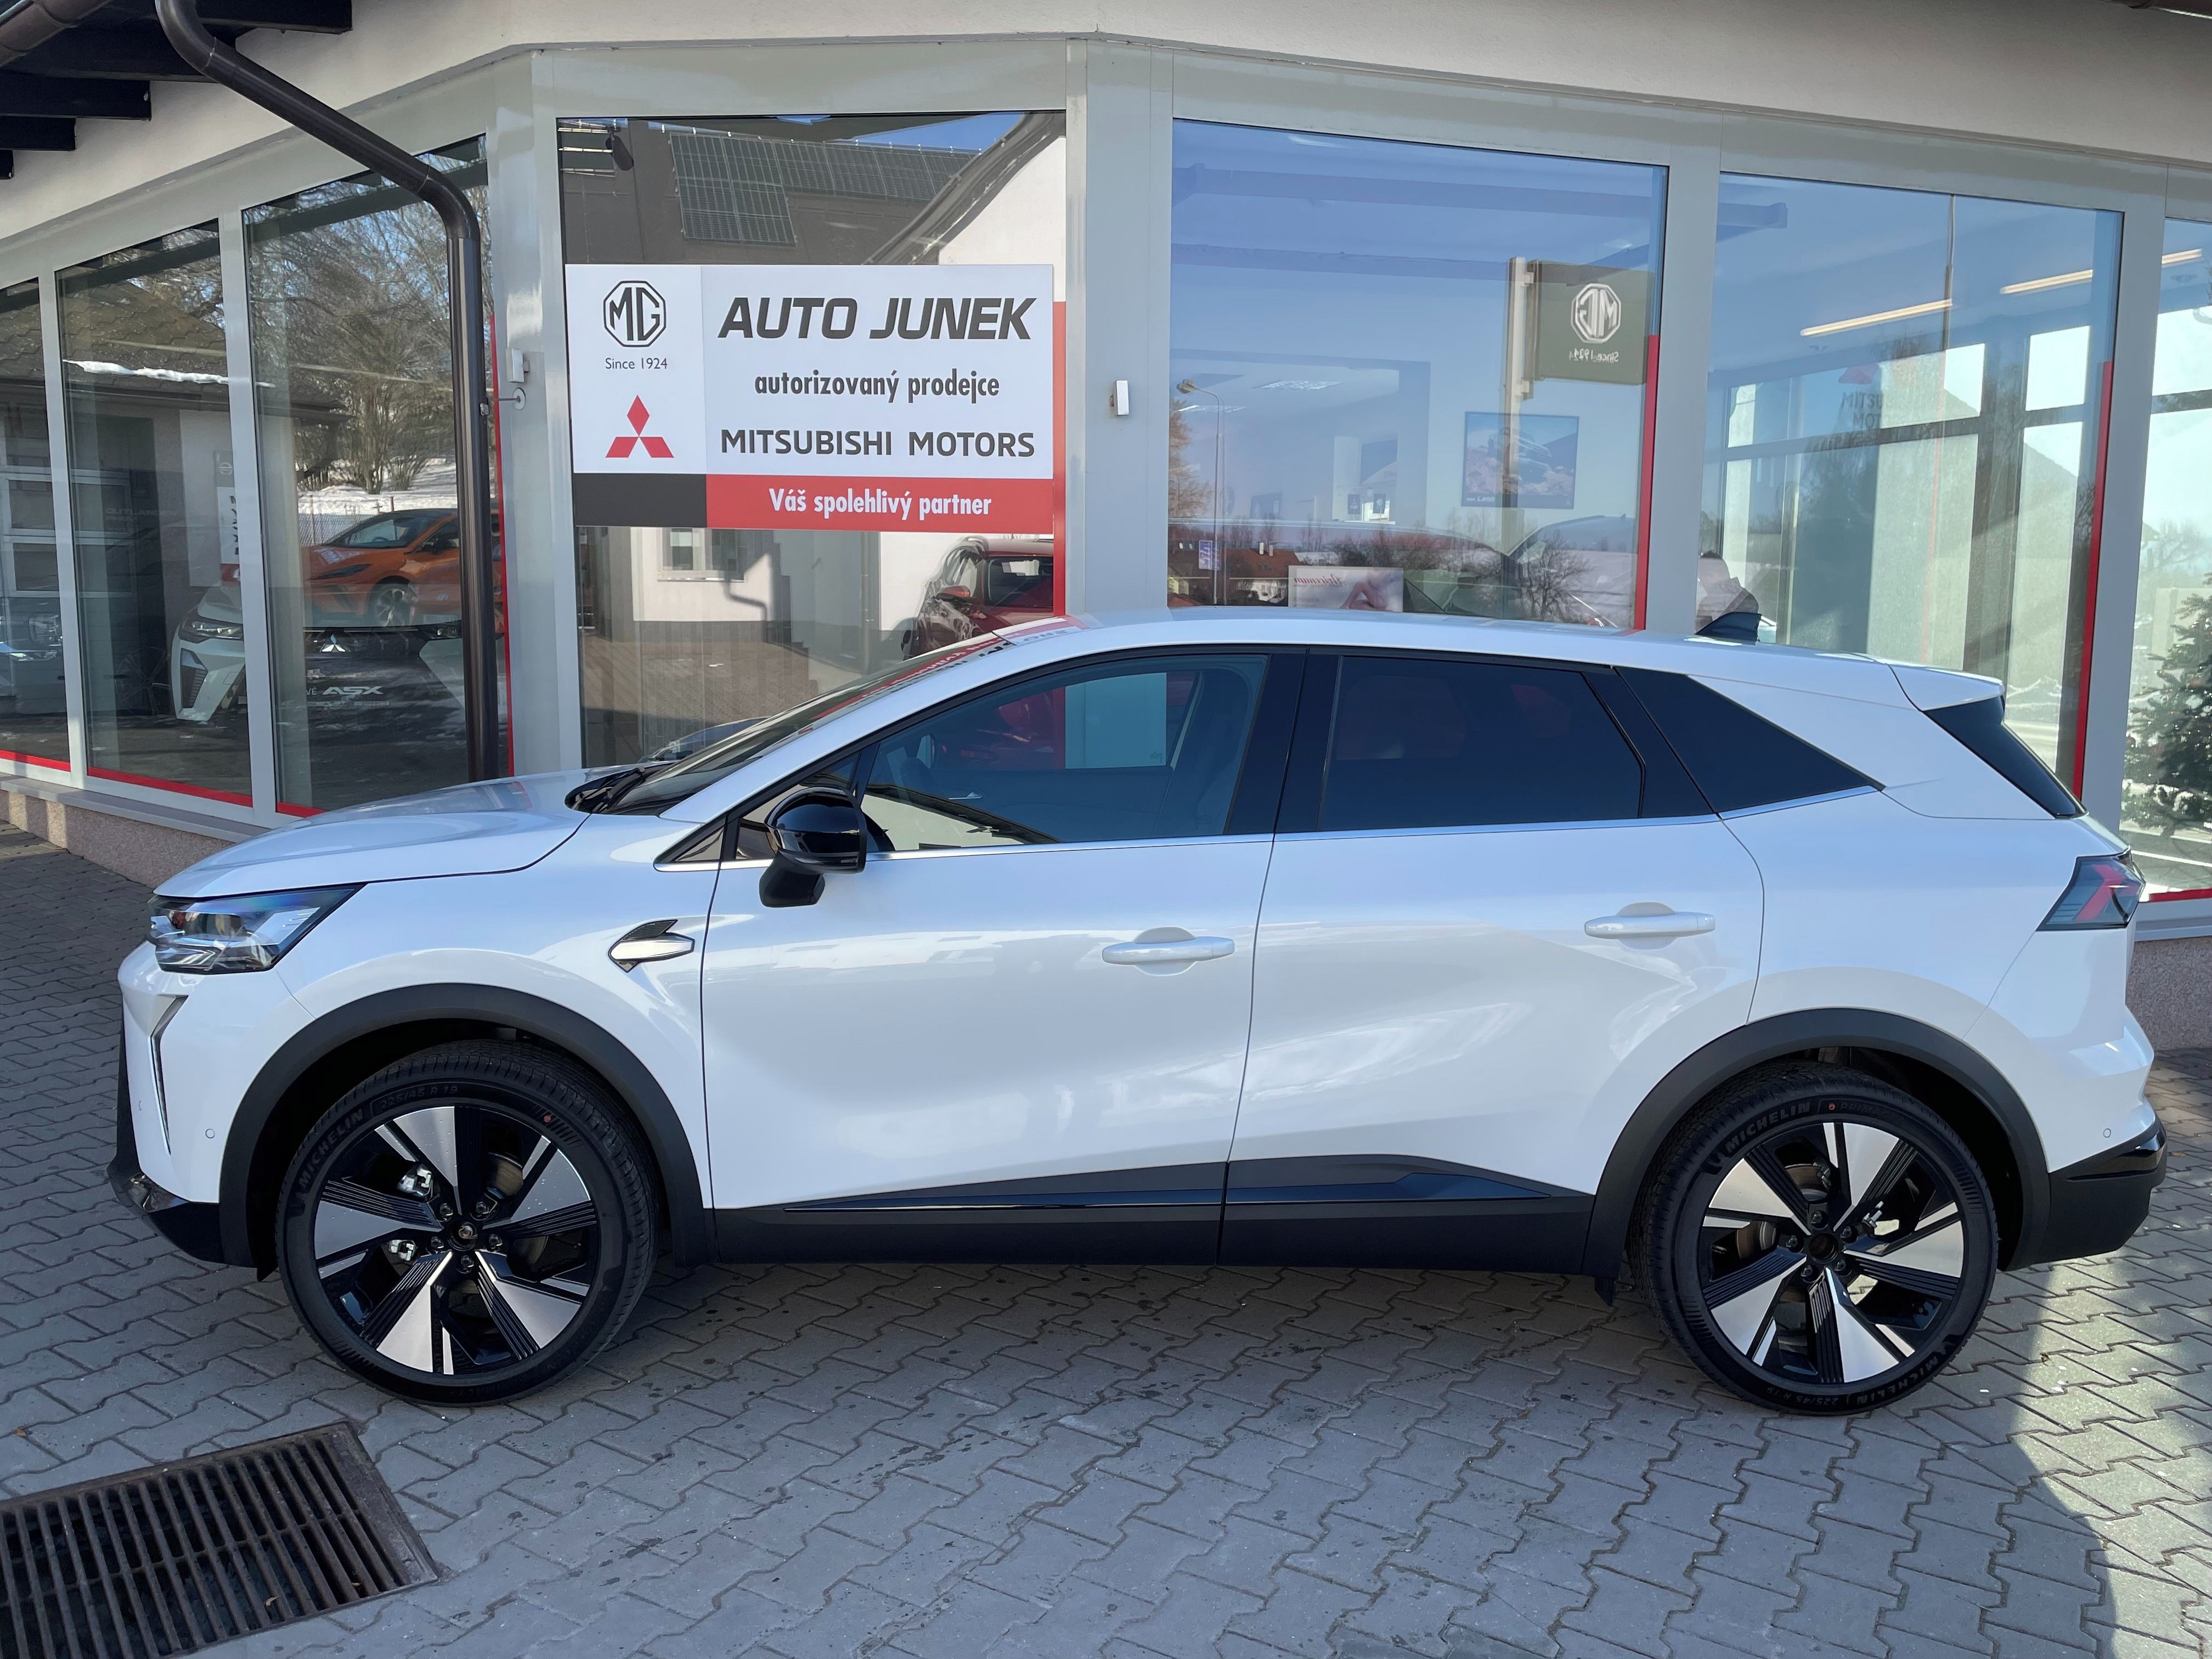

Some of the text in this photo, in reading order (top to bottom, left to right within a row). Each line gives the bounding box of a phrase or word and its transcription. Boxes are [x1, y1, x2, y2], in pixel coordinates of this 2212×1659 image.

[609, 286, 662, 342] MG
[718, 297, 1037, 339] AUTO JUNEK
[605, 358, 668, 369] Since 1924
[755, 369, 1000, 404] autorizovaný prodejce
[721, 429, 1035, 457] MITSUBISHI MOTORS
[769, 488, 992, 521] Váš spolehlivý partner
[321, 686, 384, 695] ASX
[1725, 1102, 1812, 1153] MICHELIN
[299, 1109, 363, 1189] MICHELIN
[1857, 1356, 1939, 1404] MICHELIN
